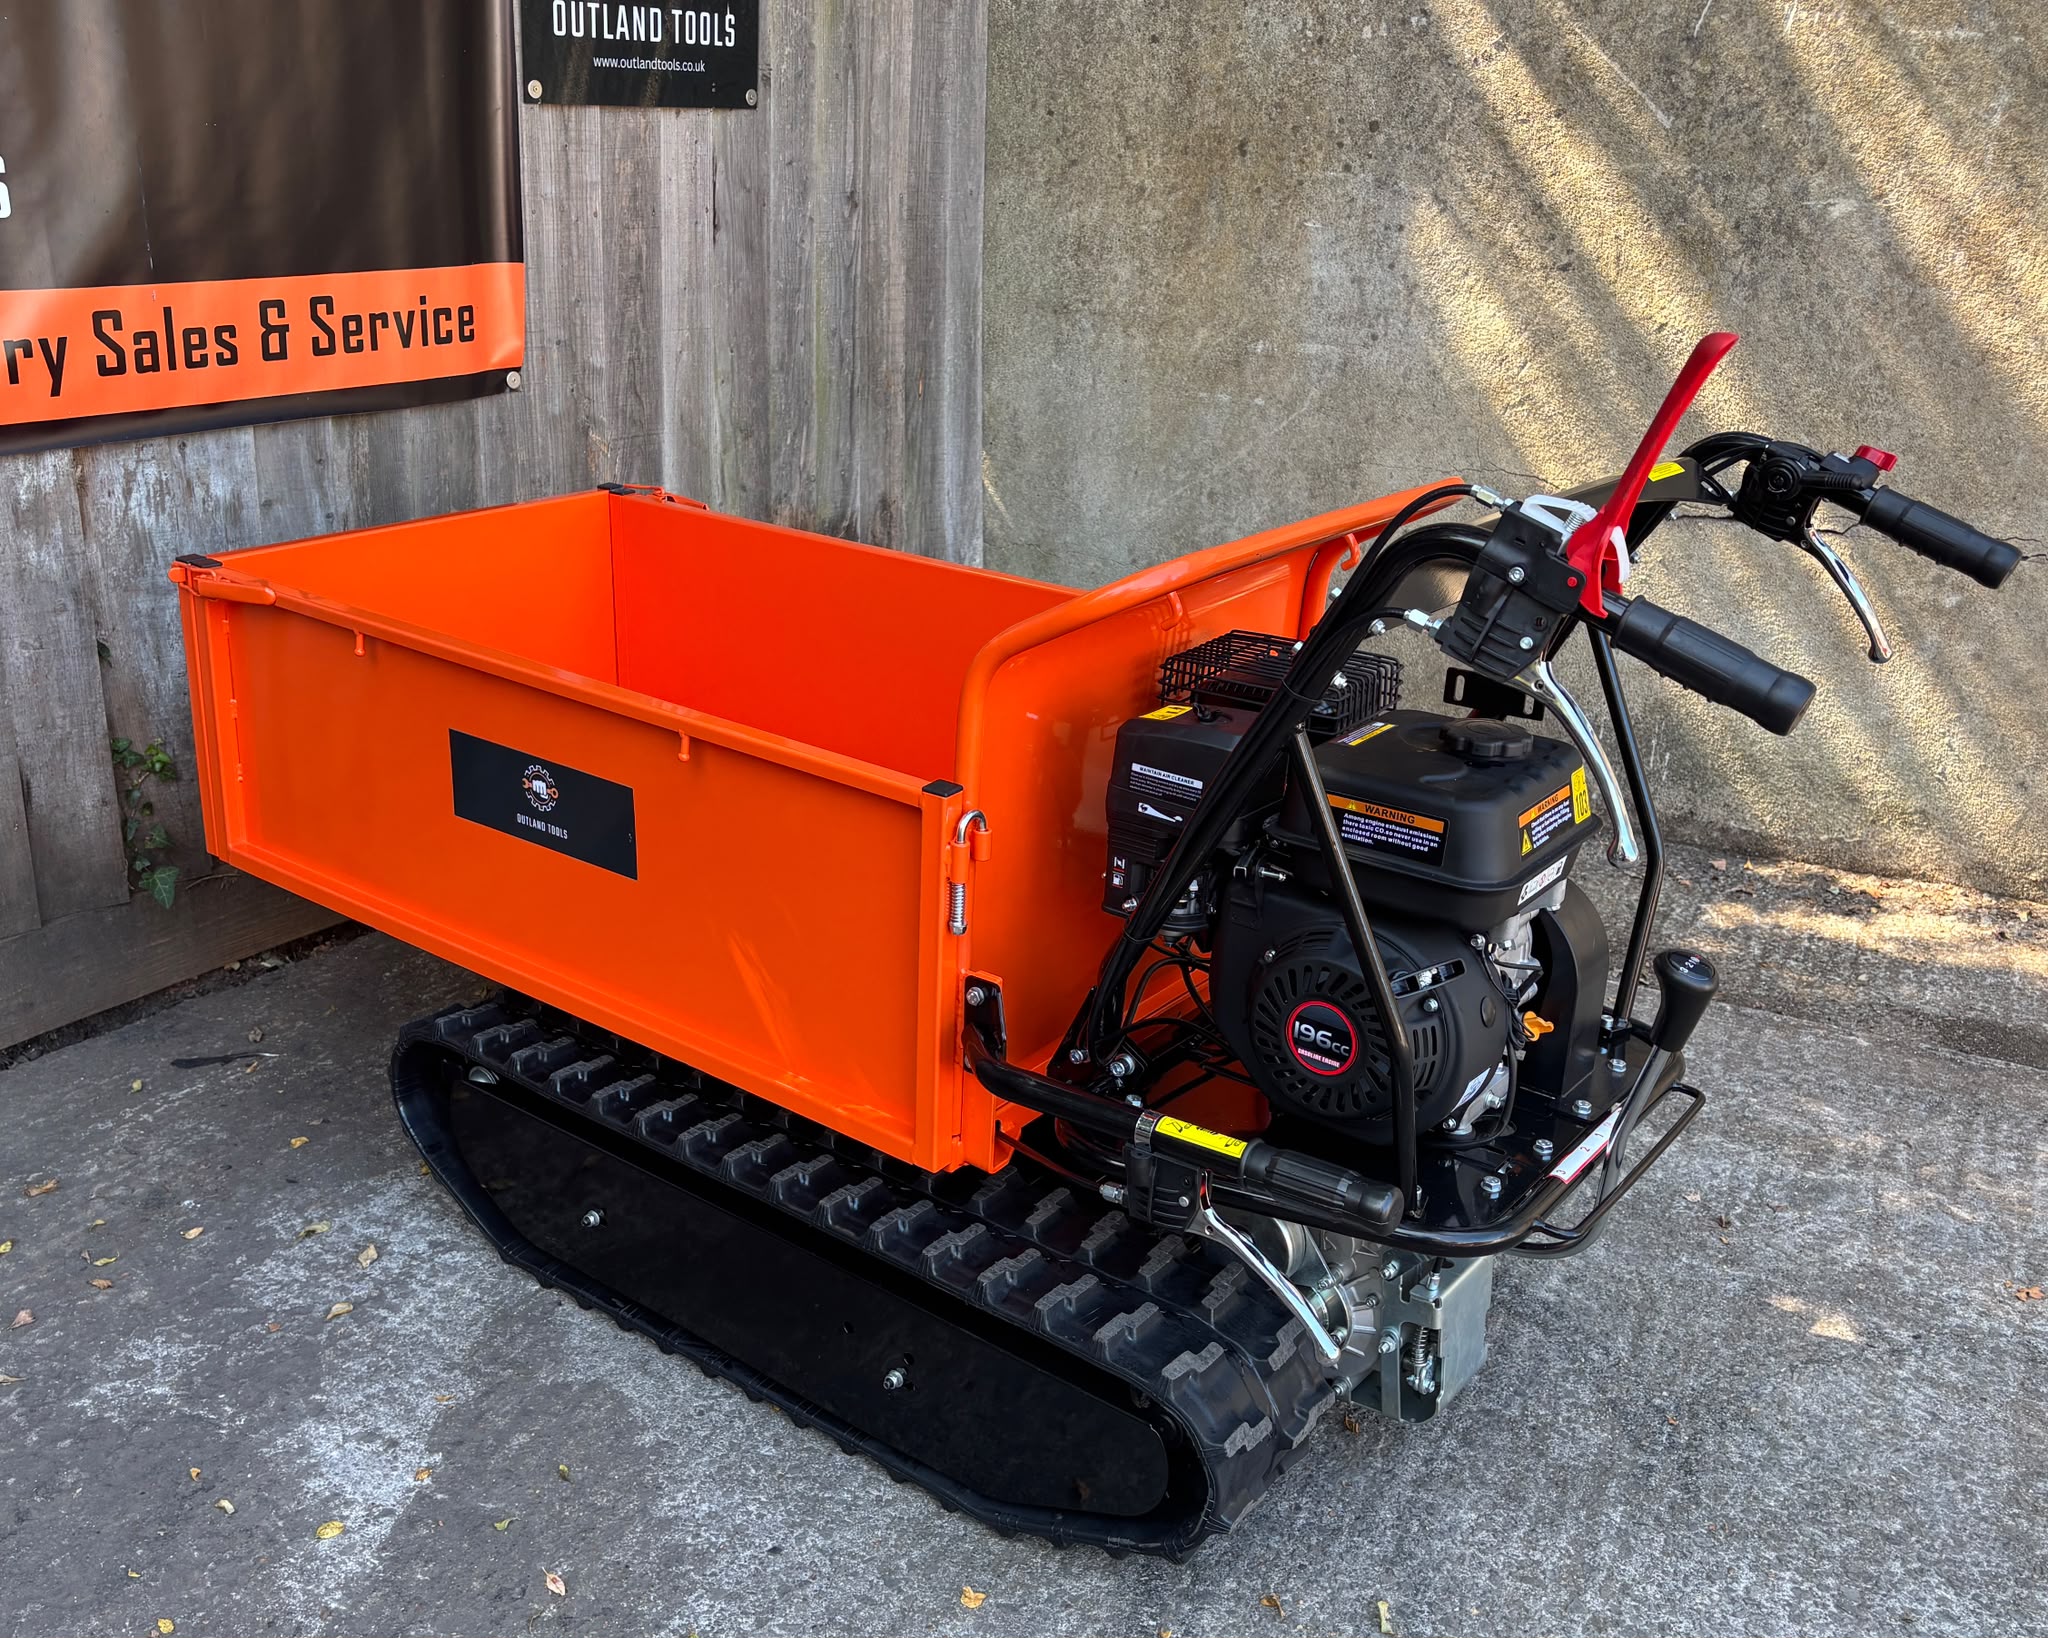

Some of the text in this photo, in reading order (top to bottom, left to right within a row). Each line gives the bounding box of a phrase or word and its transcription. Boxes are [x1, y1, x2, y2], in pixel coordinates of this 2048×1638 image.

[552, 0, 736, 47] OUTLAND TOOLS
[593, 56, 706, 73] www.outlandtools.co.uk
[92, 306, 239, 377] Sales
[259, 299, 290, 361] &
[309, 295, 475, 356] Service
[1139, 767, 1162, 777] MAINTAIN
[1171, 775, 1195, 786] CLEANER
[1364, 804, 1416, 824] WARNING
[1537, 793, 1559, 813] WARNING
[1576, 790, 1588, 818] 103
[516, 813, 568, 840] OUTLAND TOOLS
[1343, 812, 1365, 824] Among
[1365, 818, 1385, 828] engine
[1385, 822, 1409, 834] exhaust
[1343, 819, 1359, 828] there
[1359, 823, 1374, 832] toxic
[1394, 831, 1411, 841] never
[1411, 836, 1422, 844] use
[1341, 825, 1429, 852] enclosed room without good
